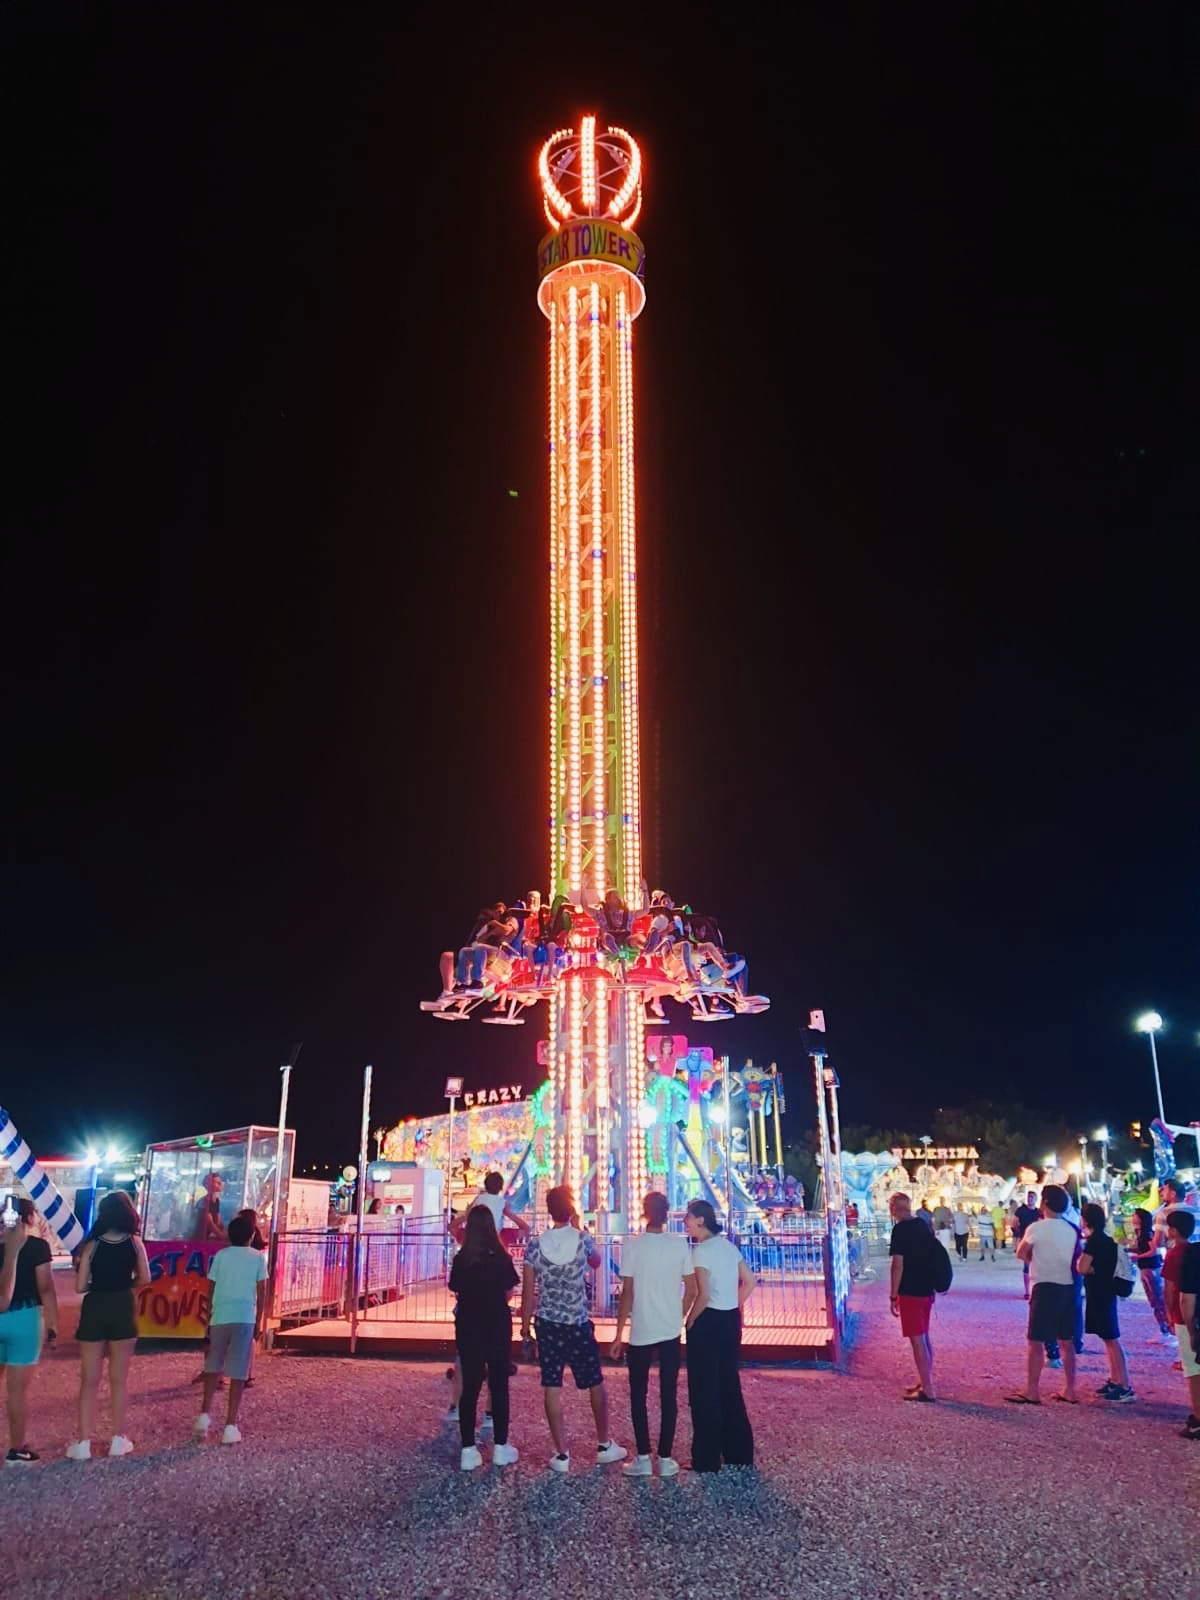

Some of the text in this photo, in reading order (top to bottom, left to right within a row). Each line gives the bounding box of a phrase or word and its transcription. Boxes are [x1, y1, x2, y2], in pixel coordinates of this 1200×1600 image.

[572, 223, 631, 260] TOWER
[463, 1085, 521, 1106] CRAZY
[138, 1287, 210, 1327] TOWE
